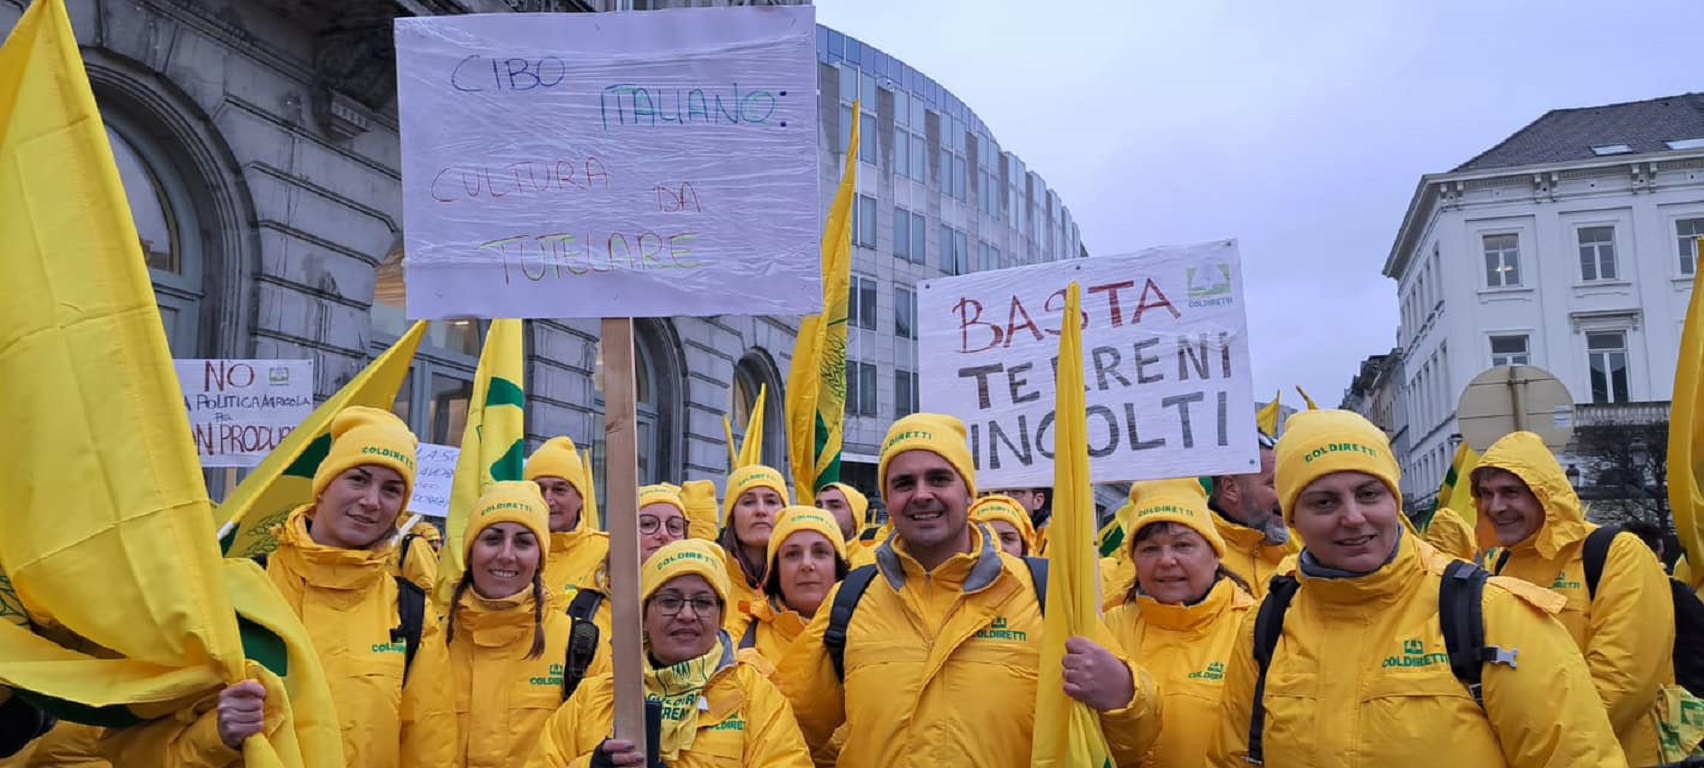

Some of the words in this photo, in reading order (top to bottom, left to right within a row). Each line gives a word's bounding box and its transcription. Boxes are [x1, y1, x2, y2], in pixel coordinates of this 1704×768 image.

[451, 54, 566, 92] CIBO
[600, 82, 788, 130] ITALIANO:
[430, 157, 609, 202] CULTURA
[653, 181, 702, 213] DA
[479, 232, 701, 285] TUTELARE
[204, 361, 255, 392] NO
[1305, 443, 1377, 463] COLDIRETTI
[1138, 505, 1194, 517] COLDIRETTI
[657, 551, 718, 571] COLDIRETTI
